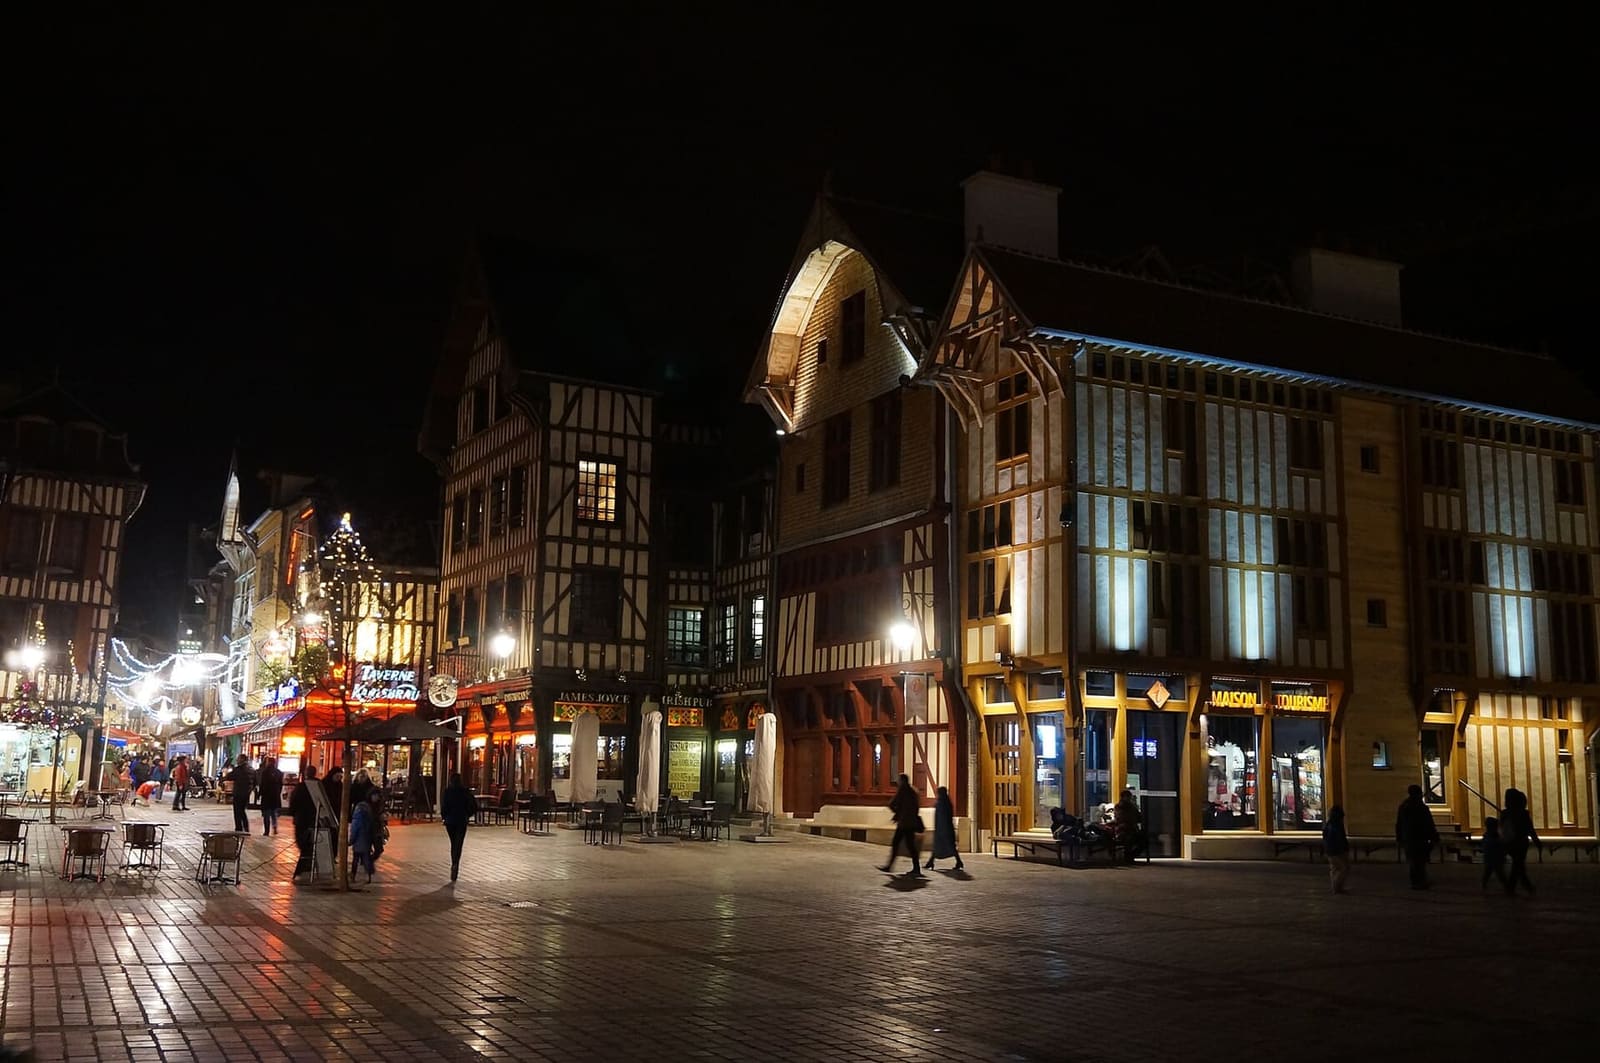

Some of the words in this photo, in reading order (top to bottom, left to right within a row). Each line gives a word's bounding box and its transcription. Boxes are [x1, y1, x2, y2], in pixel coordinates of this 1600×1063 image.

[361, 665, 416, 682] TAVERNE
[559, 691, 595, 702] JAMES
[596, 693, 631, 704] JOYCE
[662, 695, 692, 706] IRISH
[1211, 690, 1257, 708] MAISON
